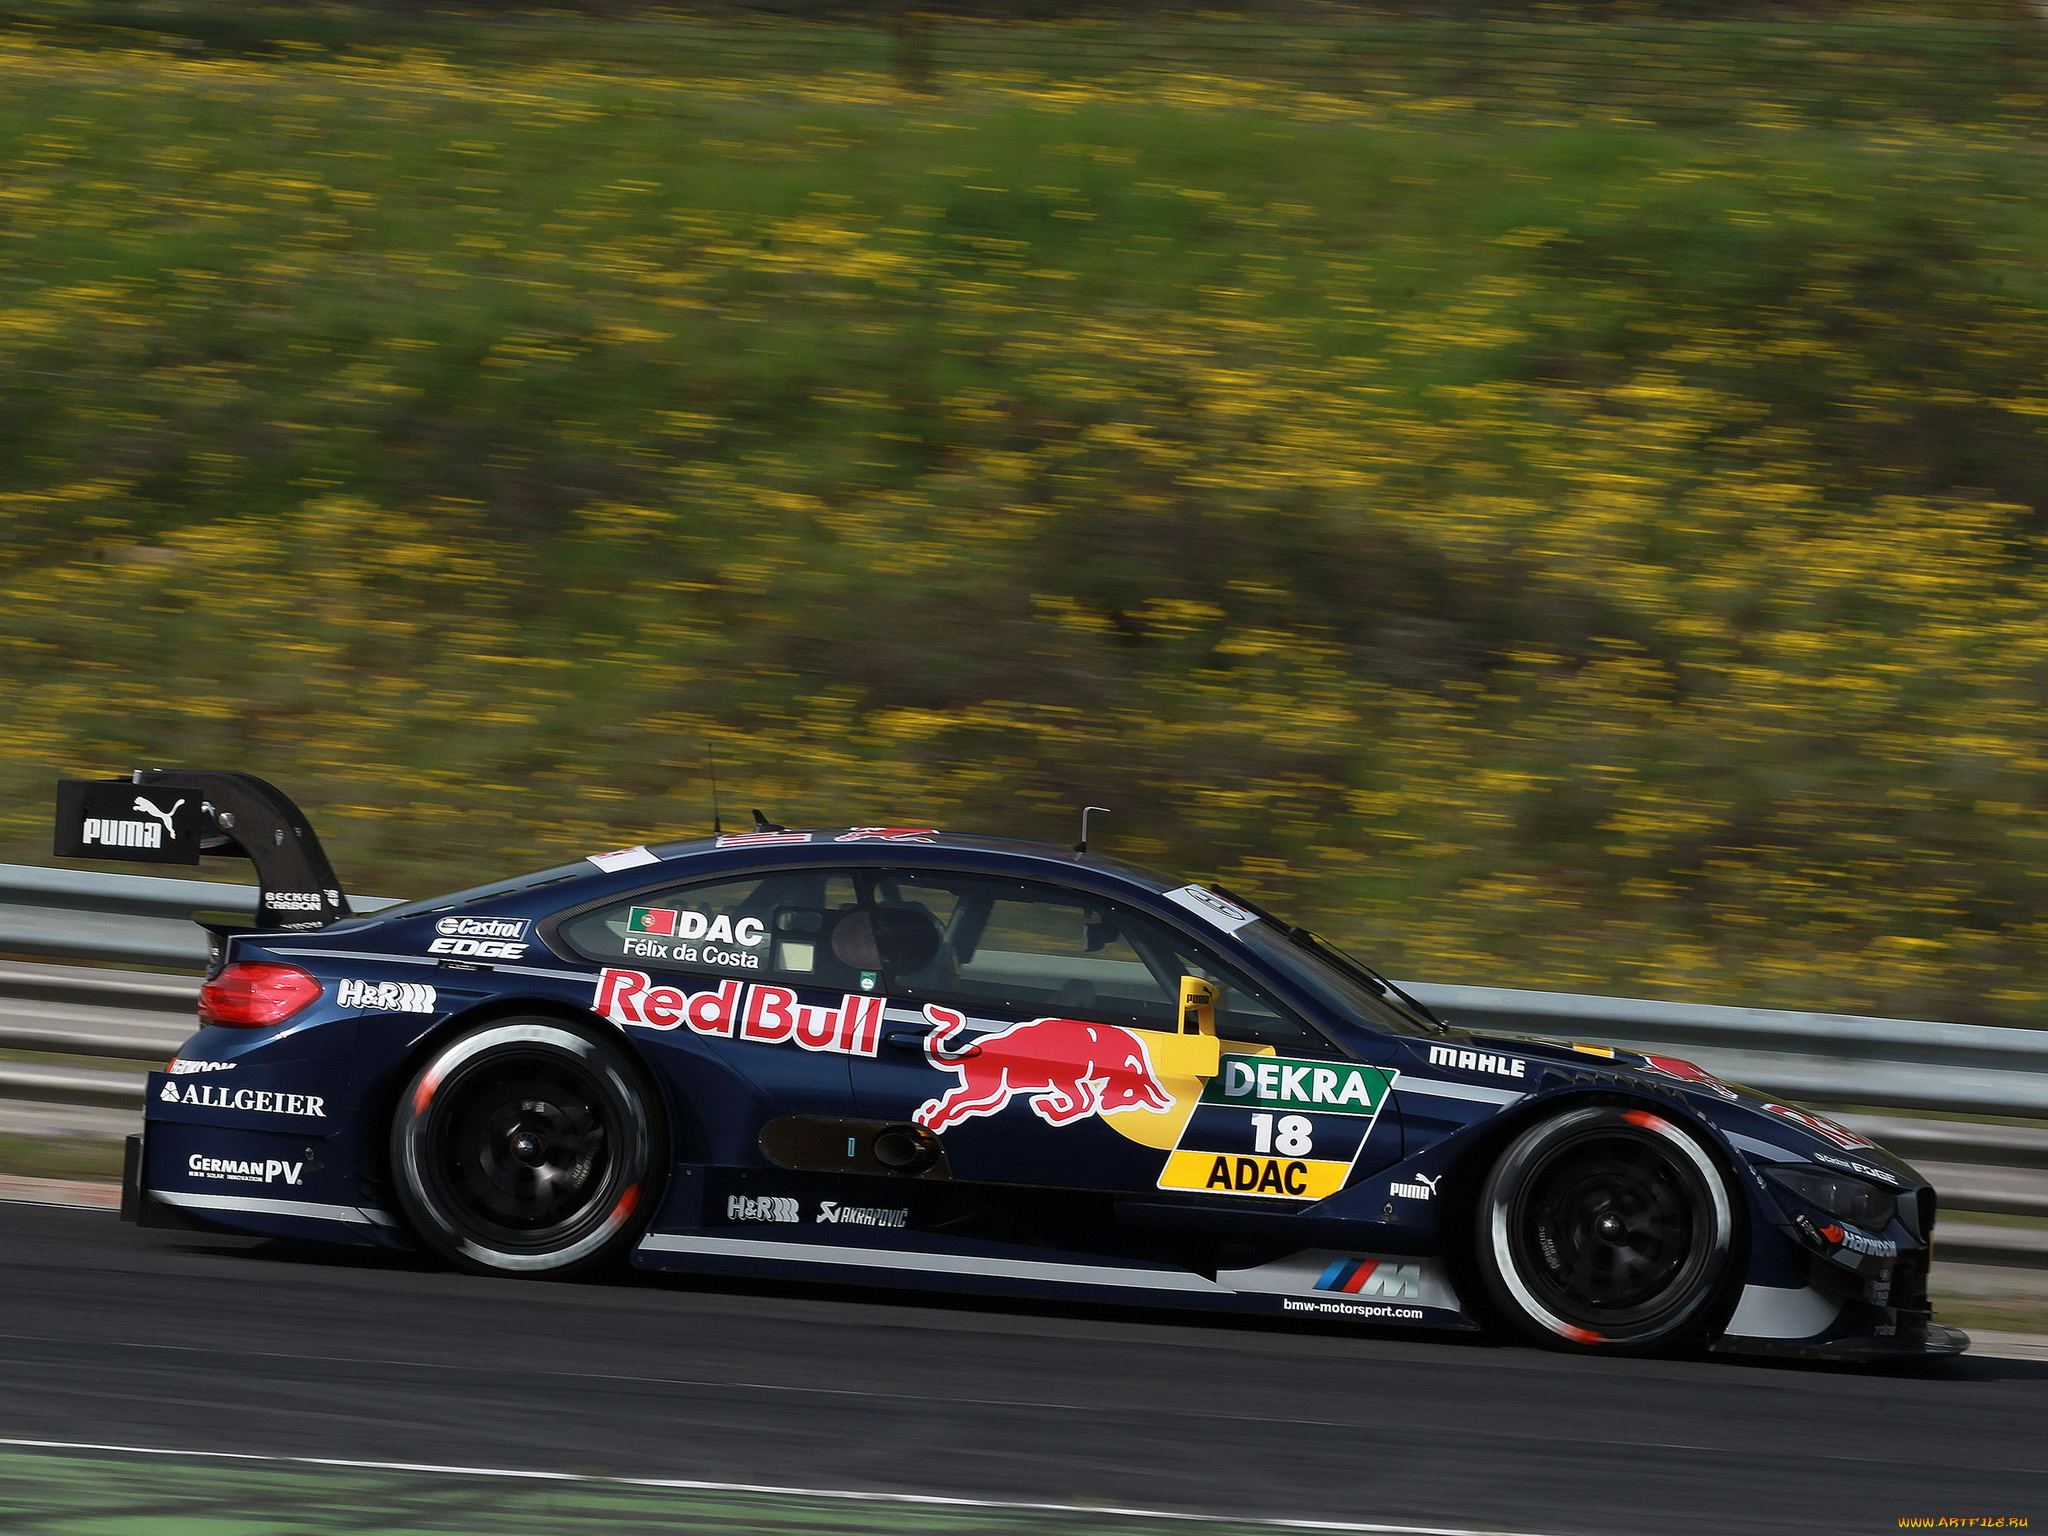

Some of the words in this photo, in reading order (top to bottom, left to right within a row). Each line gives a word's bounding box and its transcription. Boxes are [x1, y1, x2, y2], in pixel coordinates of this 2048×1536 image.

[82, 818, 162, 849] PUMA
[457, 918, 523, 938] Castrol
[678, 910, 764, 946] DAC
[427, 938, 530, 959] EDGE
[623, 938, 667, 960] Félix
[673, 943, 697, 963] da
[702, 945, 759, 969] Costa
[337, 979, 402, 1011] H&R
[592, 968, 743, 1036] Red
[741, 984, 886, 1056] Bull
[1429, 1045, 1526, 1078] MAHLE
[1225, 1061, 1372, 1108] DEKRA
[180, 1085, 326, 1117] ALLGEIER
[1251, 1112, 1312, 1156] 18
[1206, 1156, 1308, 1195] ADAC
[1390, 1182, 1429, 1200] PUMA
[1283, 1299, 1423, 1320] bmw-motorsport.com
